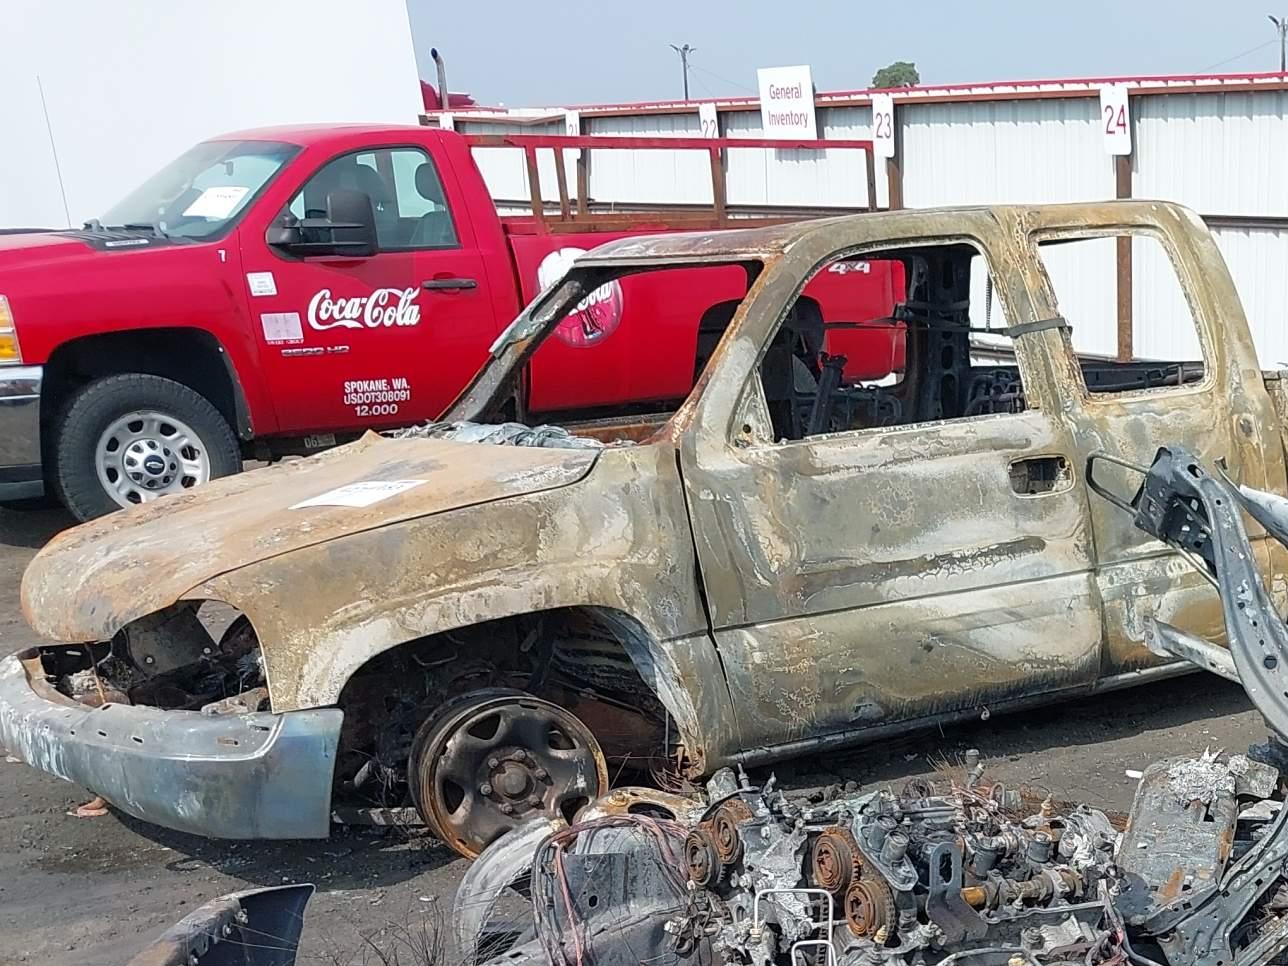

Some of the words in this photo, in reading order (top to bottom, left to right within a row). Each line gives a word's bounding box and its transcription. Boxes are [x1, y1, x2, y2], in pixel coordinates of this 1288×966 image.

[769, 82, 802, 99] General
[768, 109, 808, 128] Inventory
[876, 112, 891, 139] 23
[1104, 104, 1126, 134] 24
[308, 287, 421, 330] Coca-Cola
[344, 379, 390, 393] SPOKANE,
[392, 377, 410, 389] WA.
[343, 390, 411, 404] USDOT308091
[354, 404, 398, 416] 12,000
